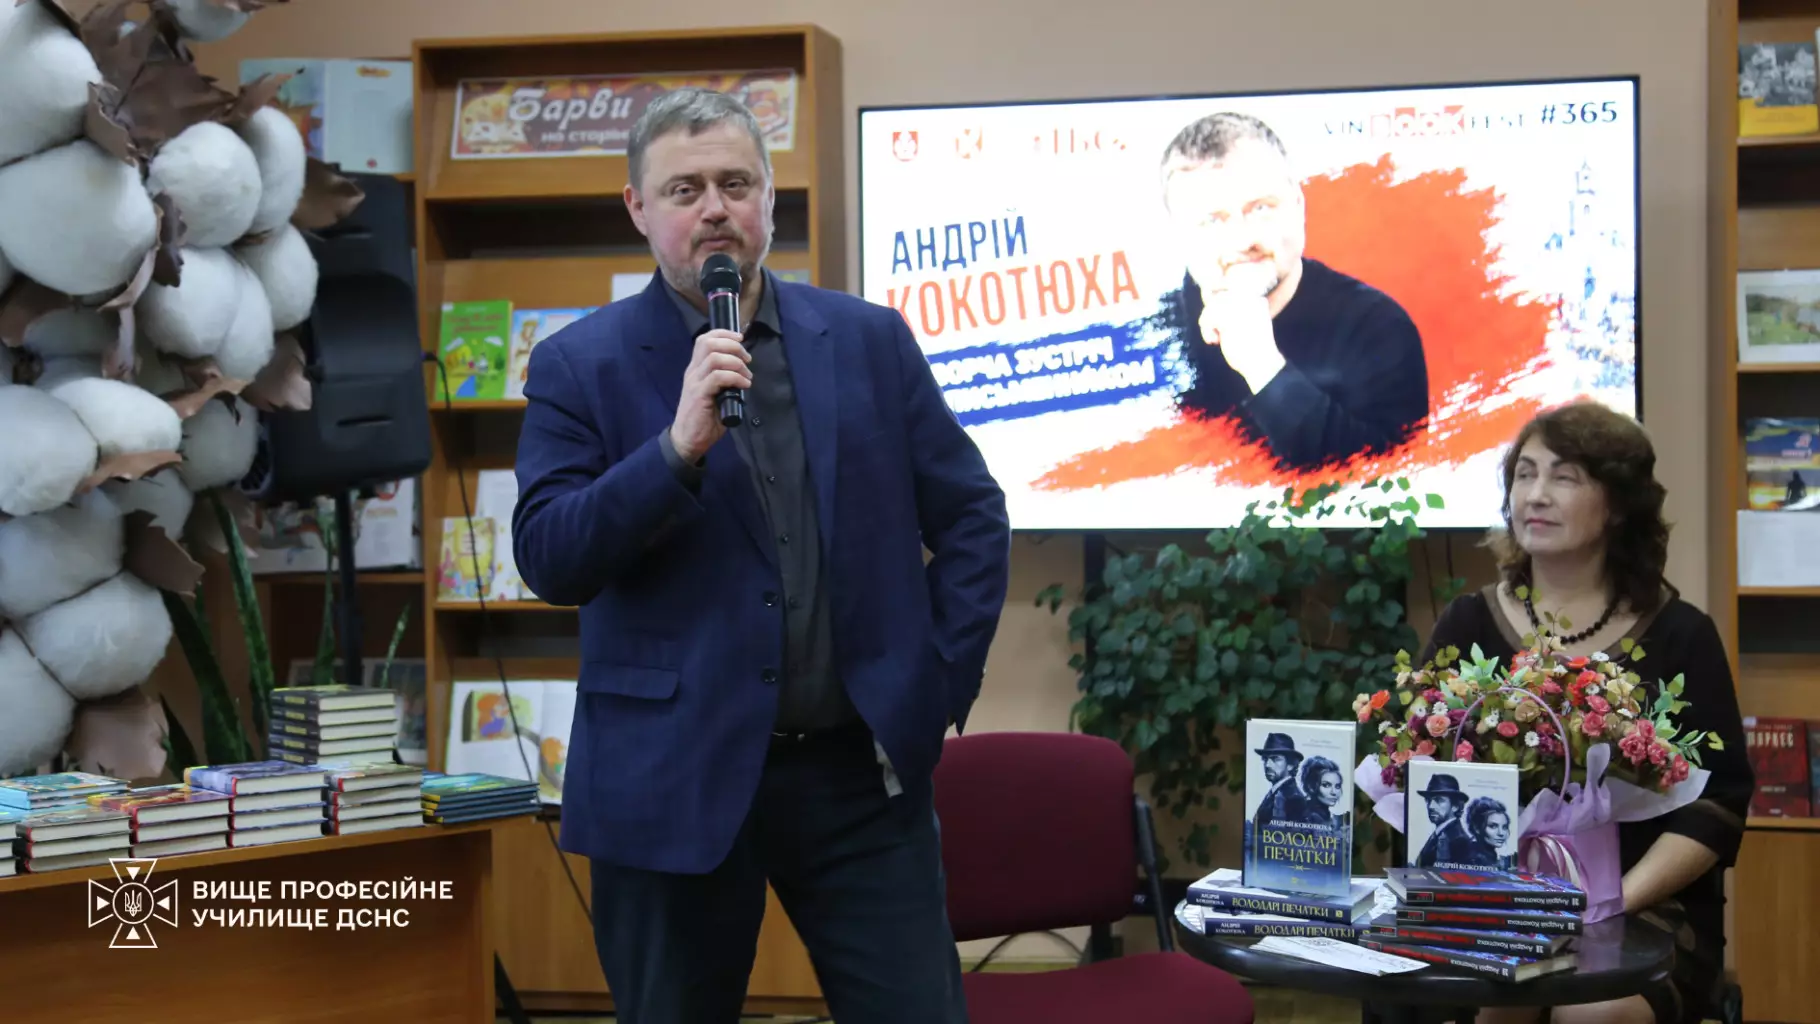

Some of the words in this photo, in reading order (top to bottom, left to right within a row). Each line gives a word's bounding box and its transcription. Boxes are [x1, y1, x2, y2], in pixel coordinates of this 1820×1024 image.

[508, 86, 634, 131] Барви
[1540, 101, 1618, 126] #365
[891, 207, 1029, 275] АНДРІЙ
[886, 249, 1141, 337] КОКОТЮХА
[1262, 829, 1339, 851] ВОЛОДАРІ
[1263, 845, 1337, 867] ПЕЧАТКИ
[1231, 897, 1280, 912] ВОЛОДАРІ
[1281, 903, 1329, 918] ПЕЧАТКИ
[1254, 925, 1305, 937] ВОЛОДАРІ
[1306, 926, 1355, 938] ПЕЧАТКИ
